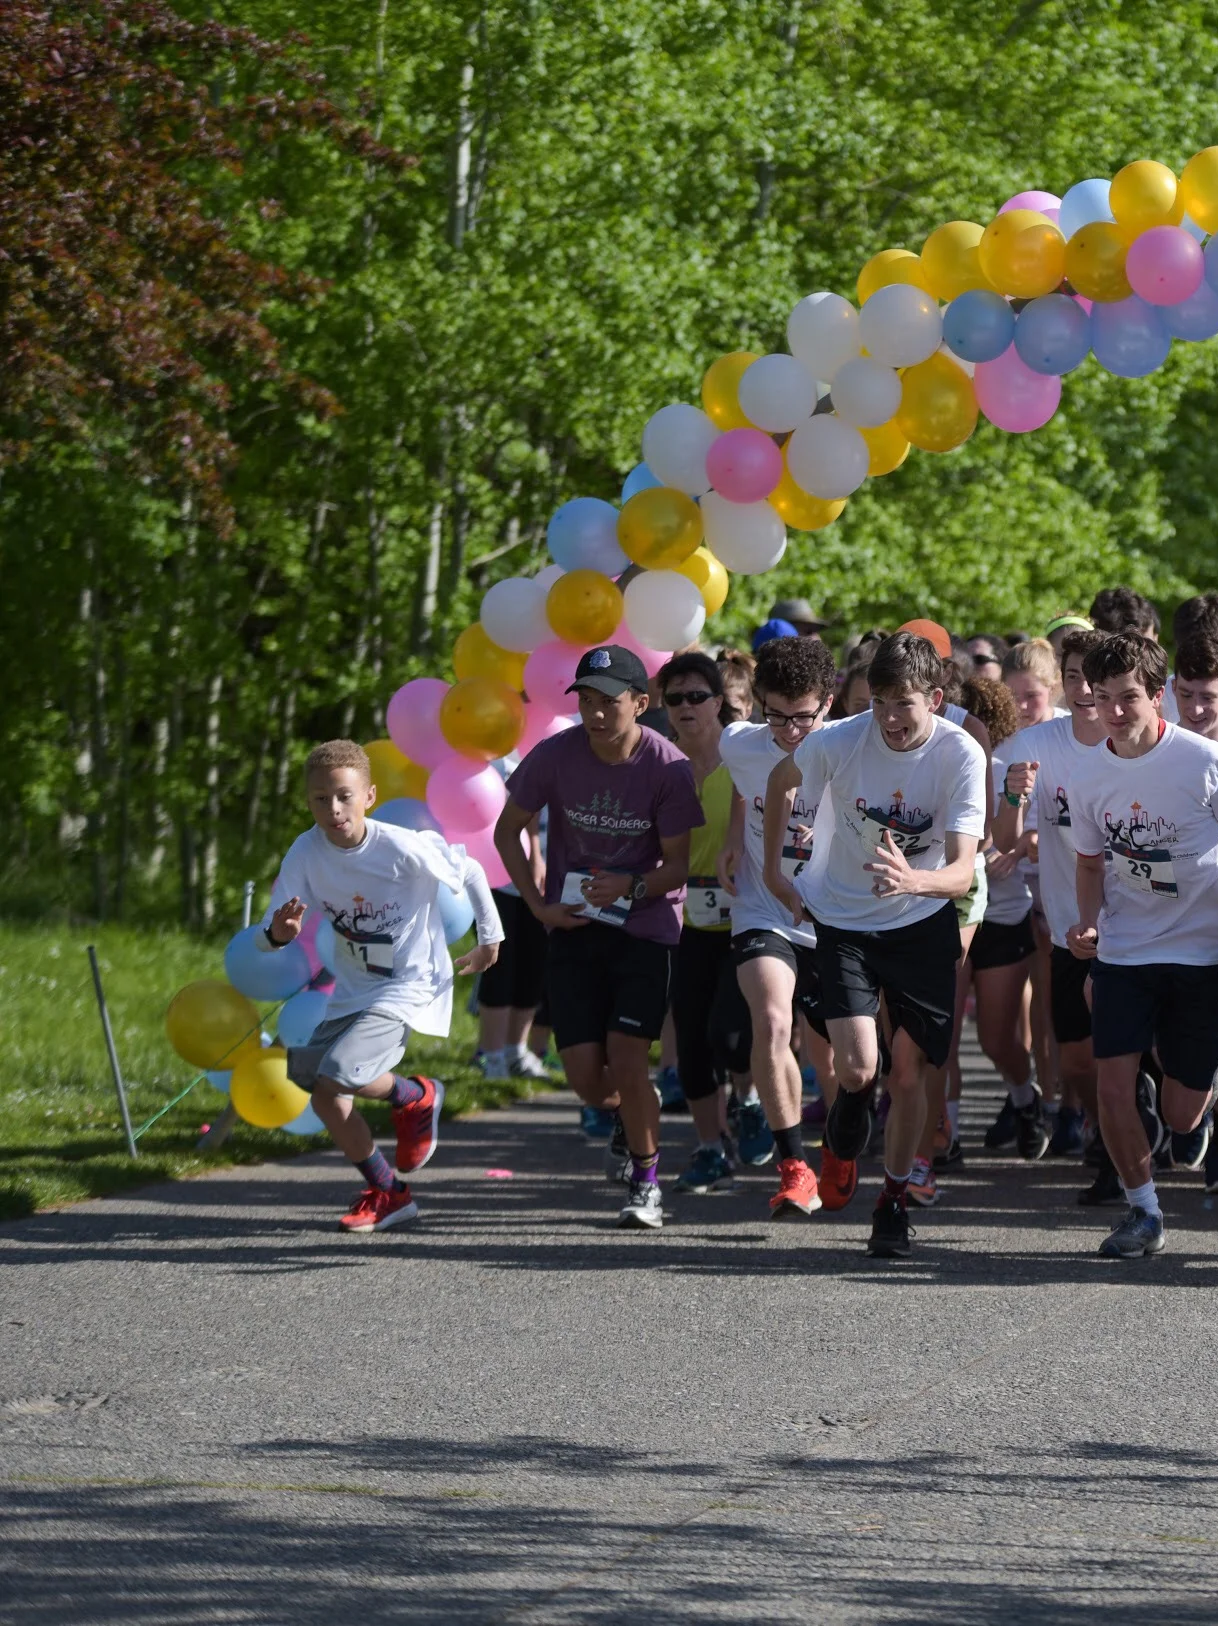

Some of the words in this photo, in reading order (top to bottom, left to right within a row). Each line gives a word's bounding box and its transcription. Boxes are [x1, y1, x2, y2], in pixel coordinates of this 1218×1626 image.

[600, 815, 652, 830] SOLBERG
[1127, 859, 1153, 879] 29
[704, 890, 717, 908] 3
